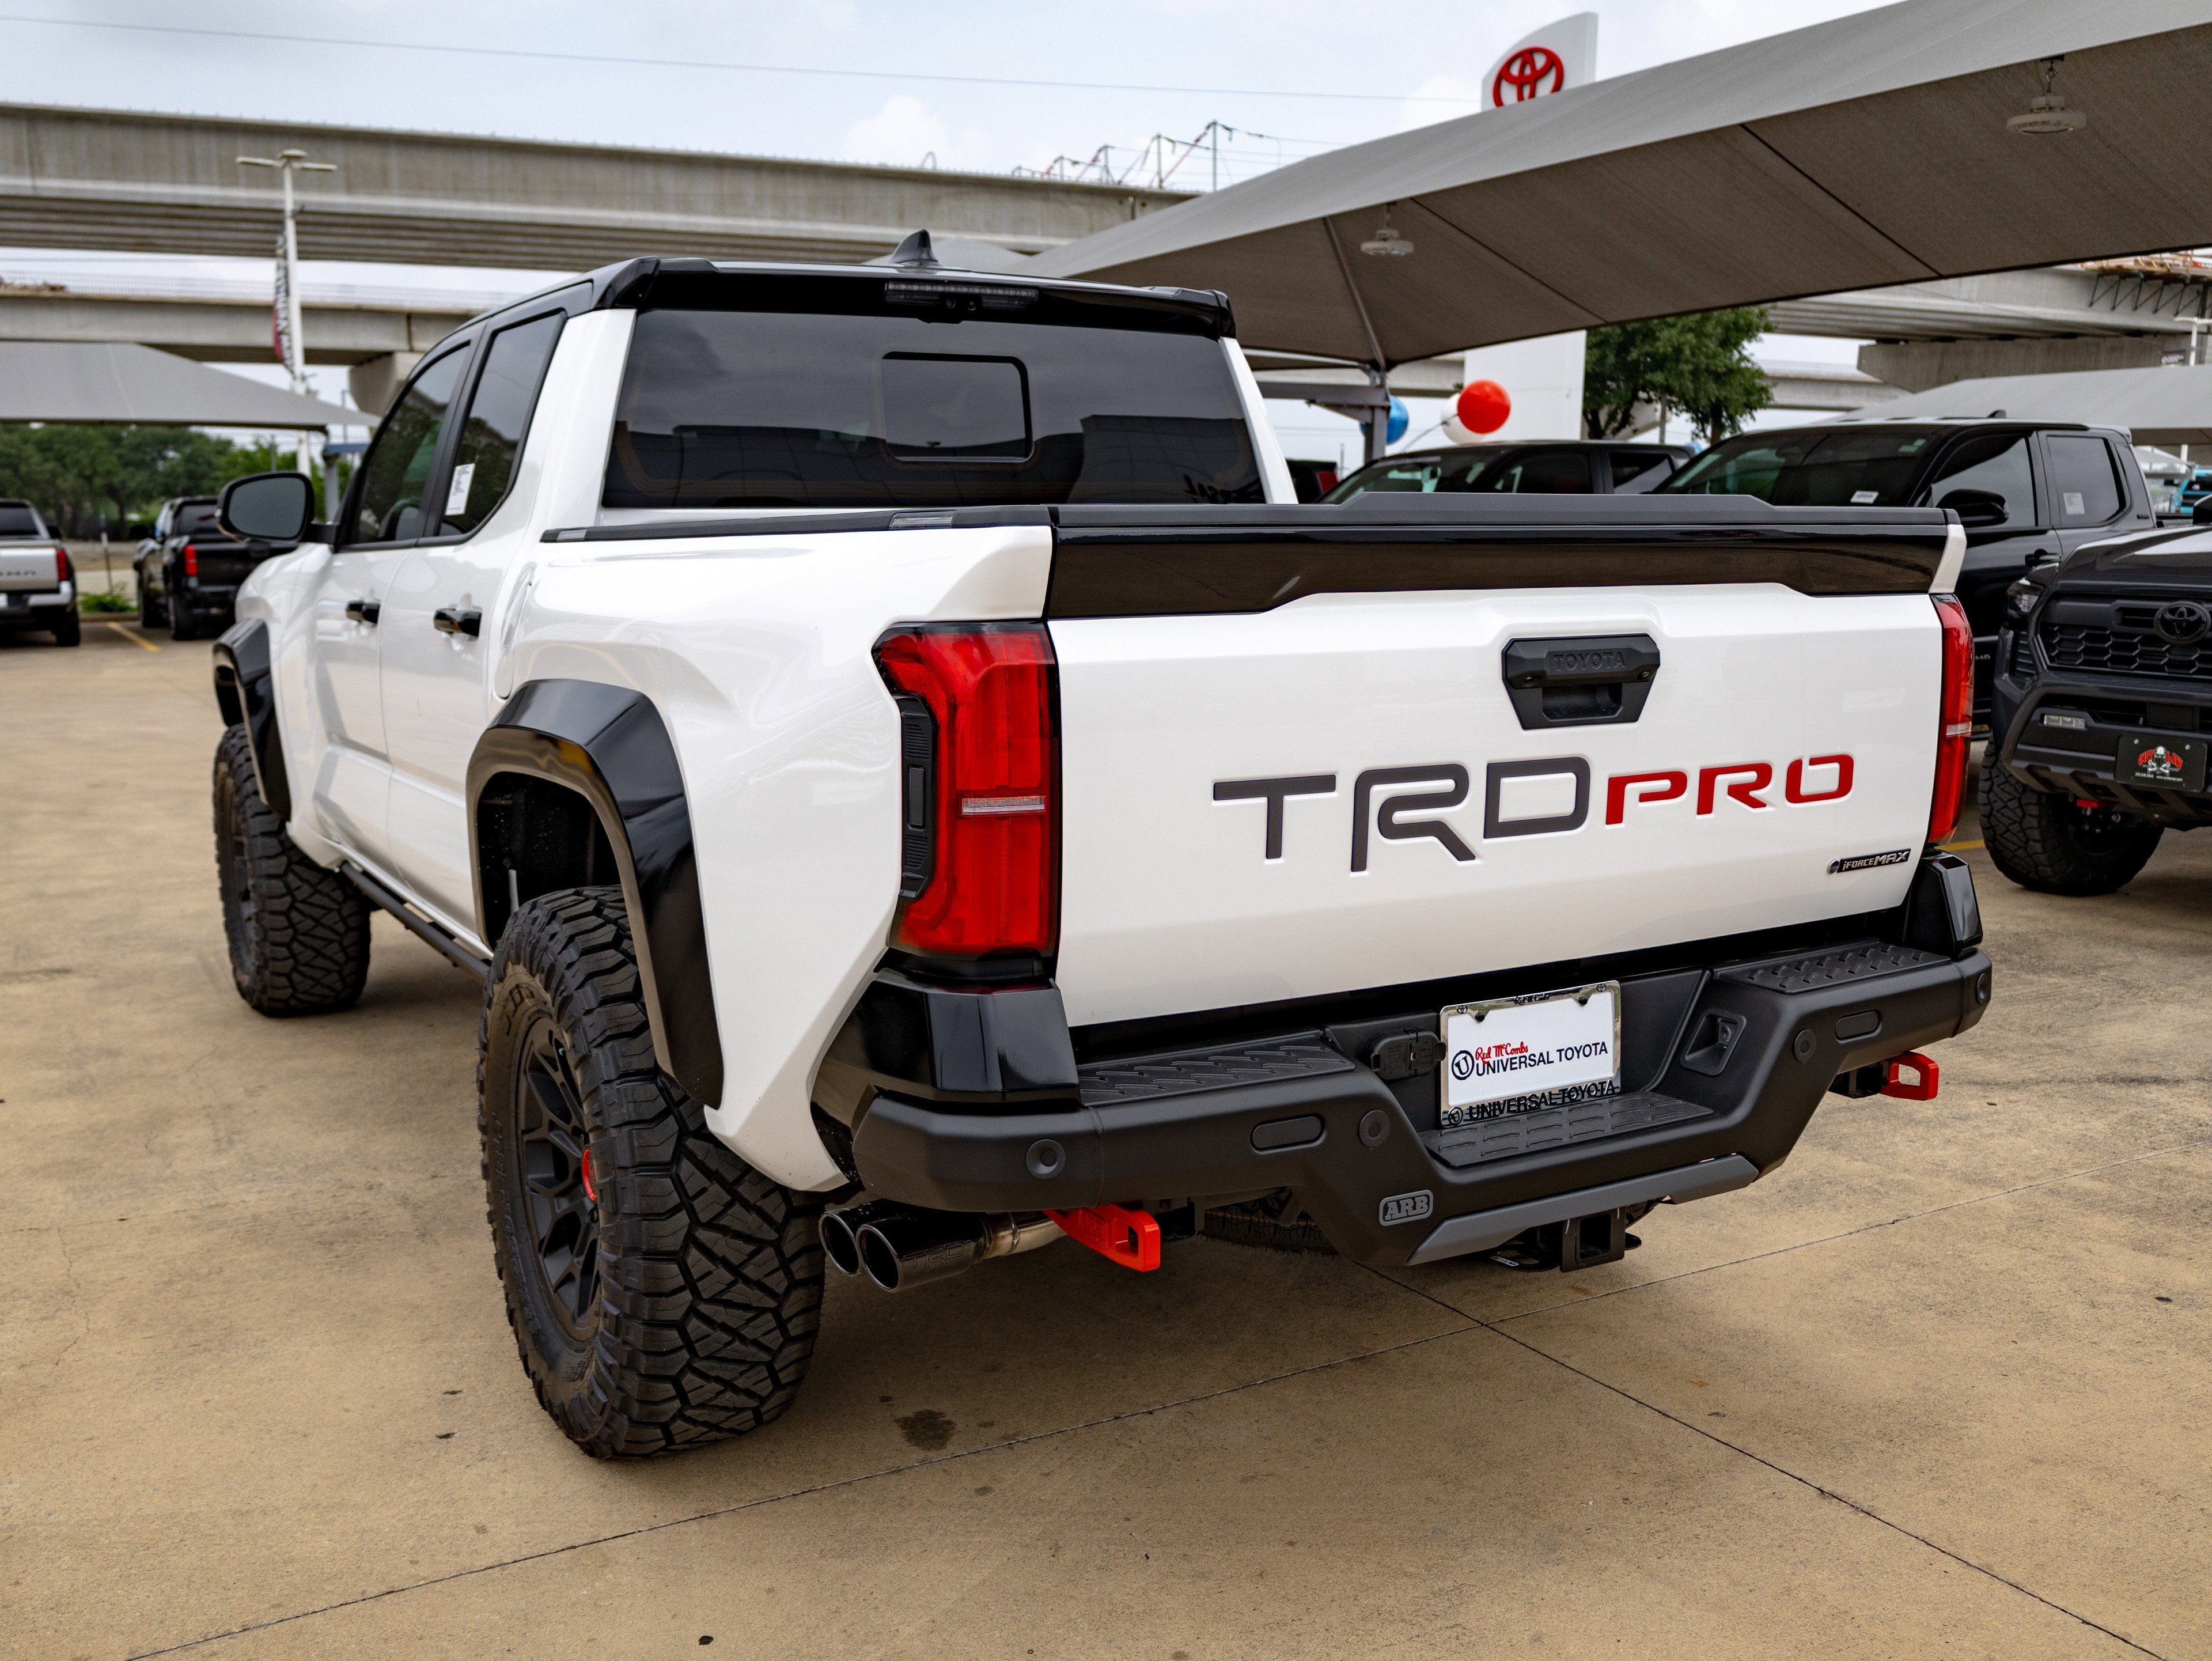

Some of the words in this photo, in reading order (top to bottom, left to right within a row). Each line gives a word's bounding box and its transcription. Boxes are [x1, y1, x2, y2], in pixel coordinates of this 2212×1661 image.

[1553, 651, 1626, 671] TOYOTA
[1213, 756, 1591, 872] TRD
[1605, 754, 1854, 826] PRO
[1475, 1047, 1491, 1064] Red
[1475, 1050, 1554, 1076] UNIVERSAL
[1556, 1041, 1608, 1062] TOYOTA
[1469, 1091, 1557, 1121] UNIVERSAL
[1558, 1079, 1615, 1104] TOYOTA
[1385, 1195, 1429, 1220] ARB
